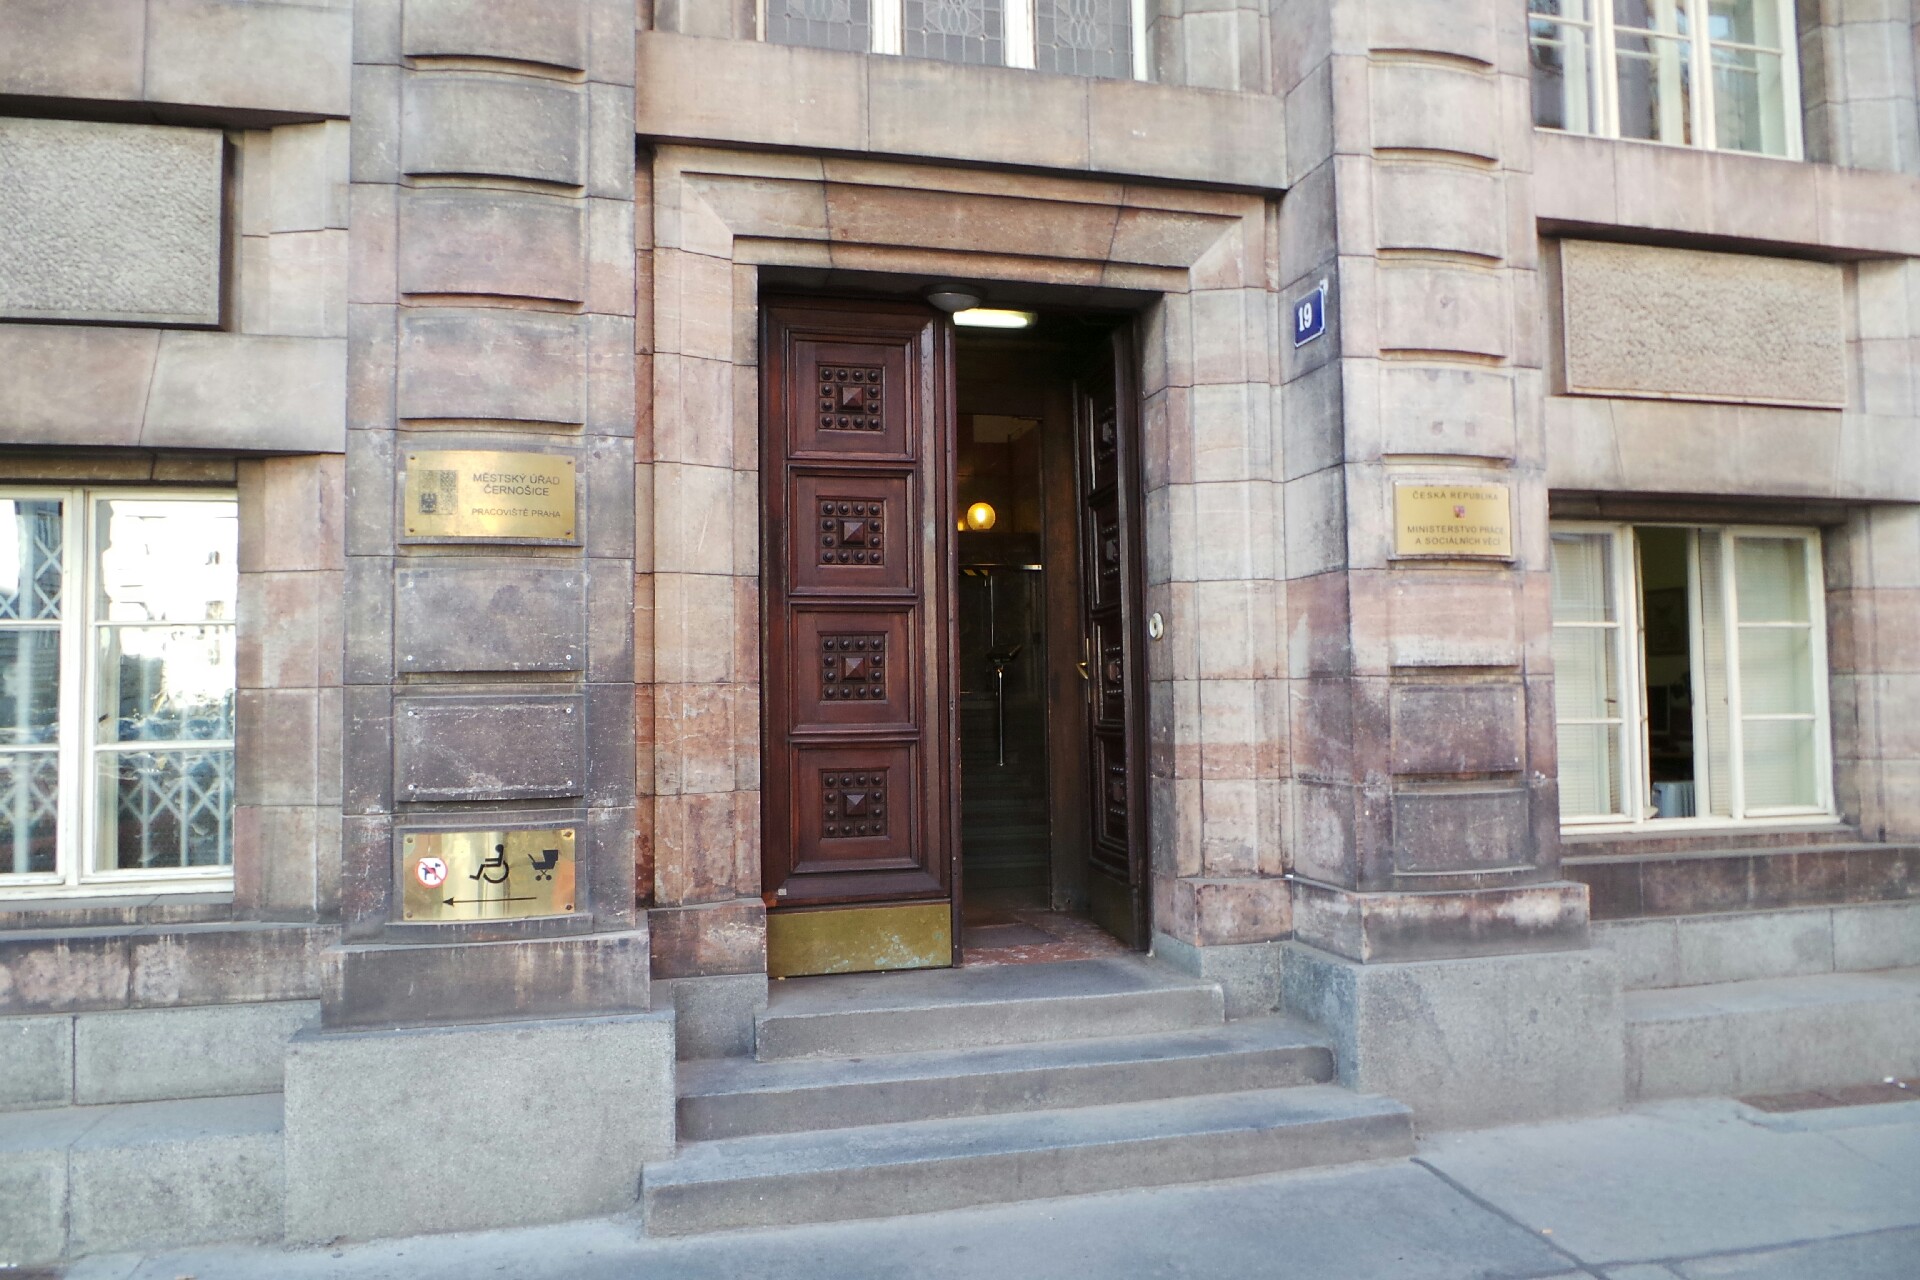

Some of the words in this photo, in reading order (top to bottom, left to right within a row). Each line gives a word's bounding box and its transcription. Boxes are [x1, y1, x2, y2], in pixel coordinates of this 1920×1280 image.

[1298, 302, 1312, 332] 19
[473, 473, 526, 483] MĚSTSKÝ
[530, 474, 560, 485] ÚŘAD
[484, 484, 549, 496] ČERNOŠICE
[1450, 492, 1498, 500] REPUBLIKA
[471, 507, 528, 517] PRACOVIŠTĚ
[531, 509, 560, 518] PRAHA
[1407, 525, 1477, 534] MINISTERSTVO
[1425, 536, 1480, 545] SOCIÁLNÍCH
